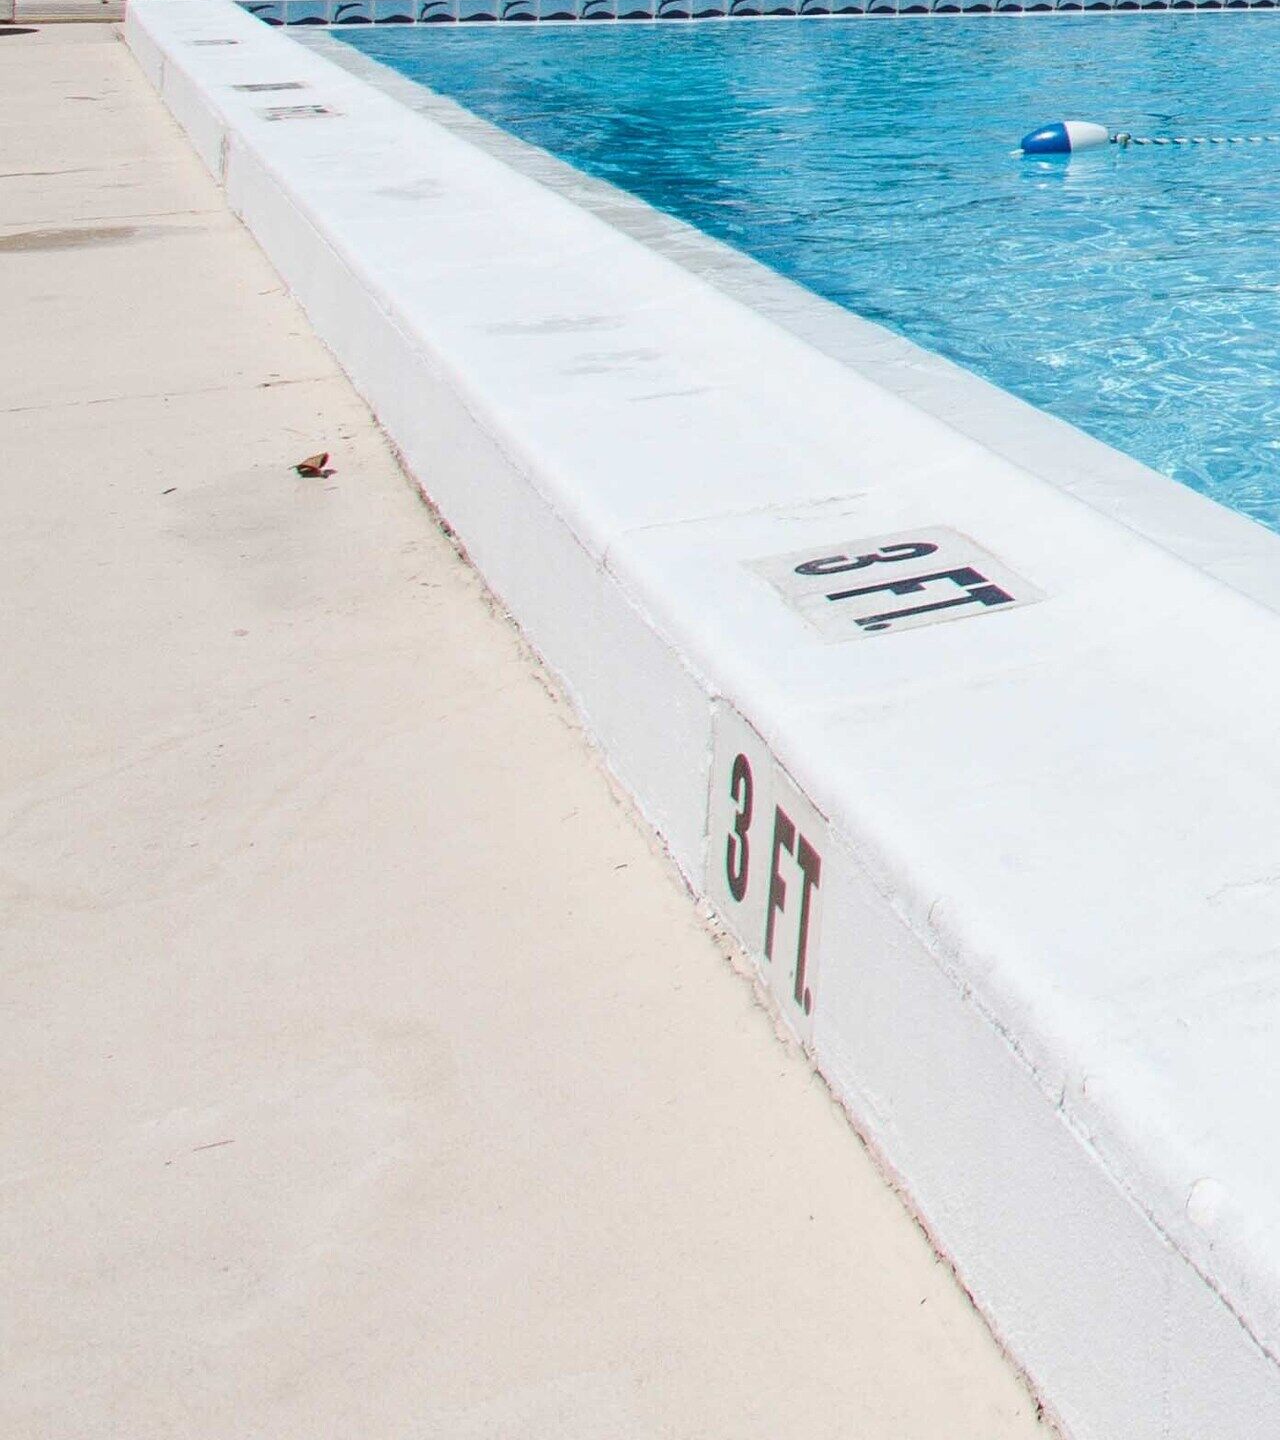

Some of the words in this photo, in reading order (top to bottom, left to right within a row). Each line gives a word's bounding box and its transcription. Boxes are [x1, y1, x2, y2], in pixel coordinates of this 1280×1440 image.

[794, 542, 939, 575] 3
[826, 566, 1016, 631] FT.
[726, 752, 754, 903] 3
[765, 803, 822, 1017] FT.
